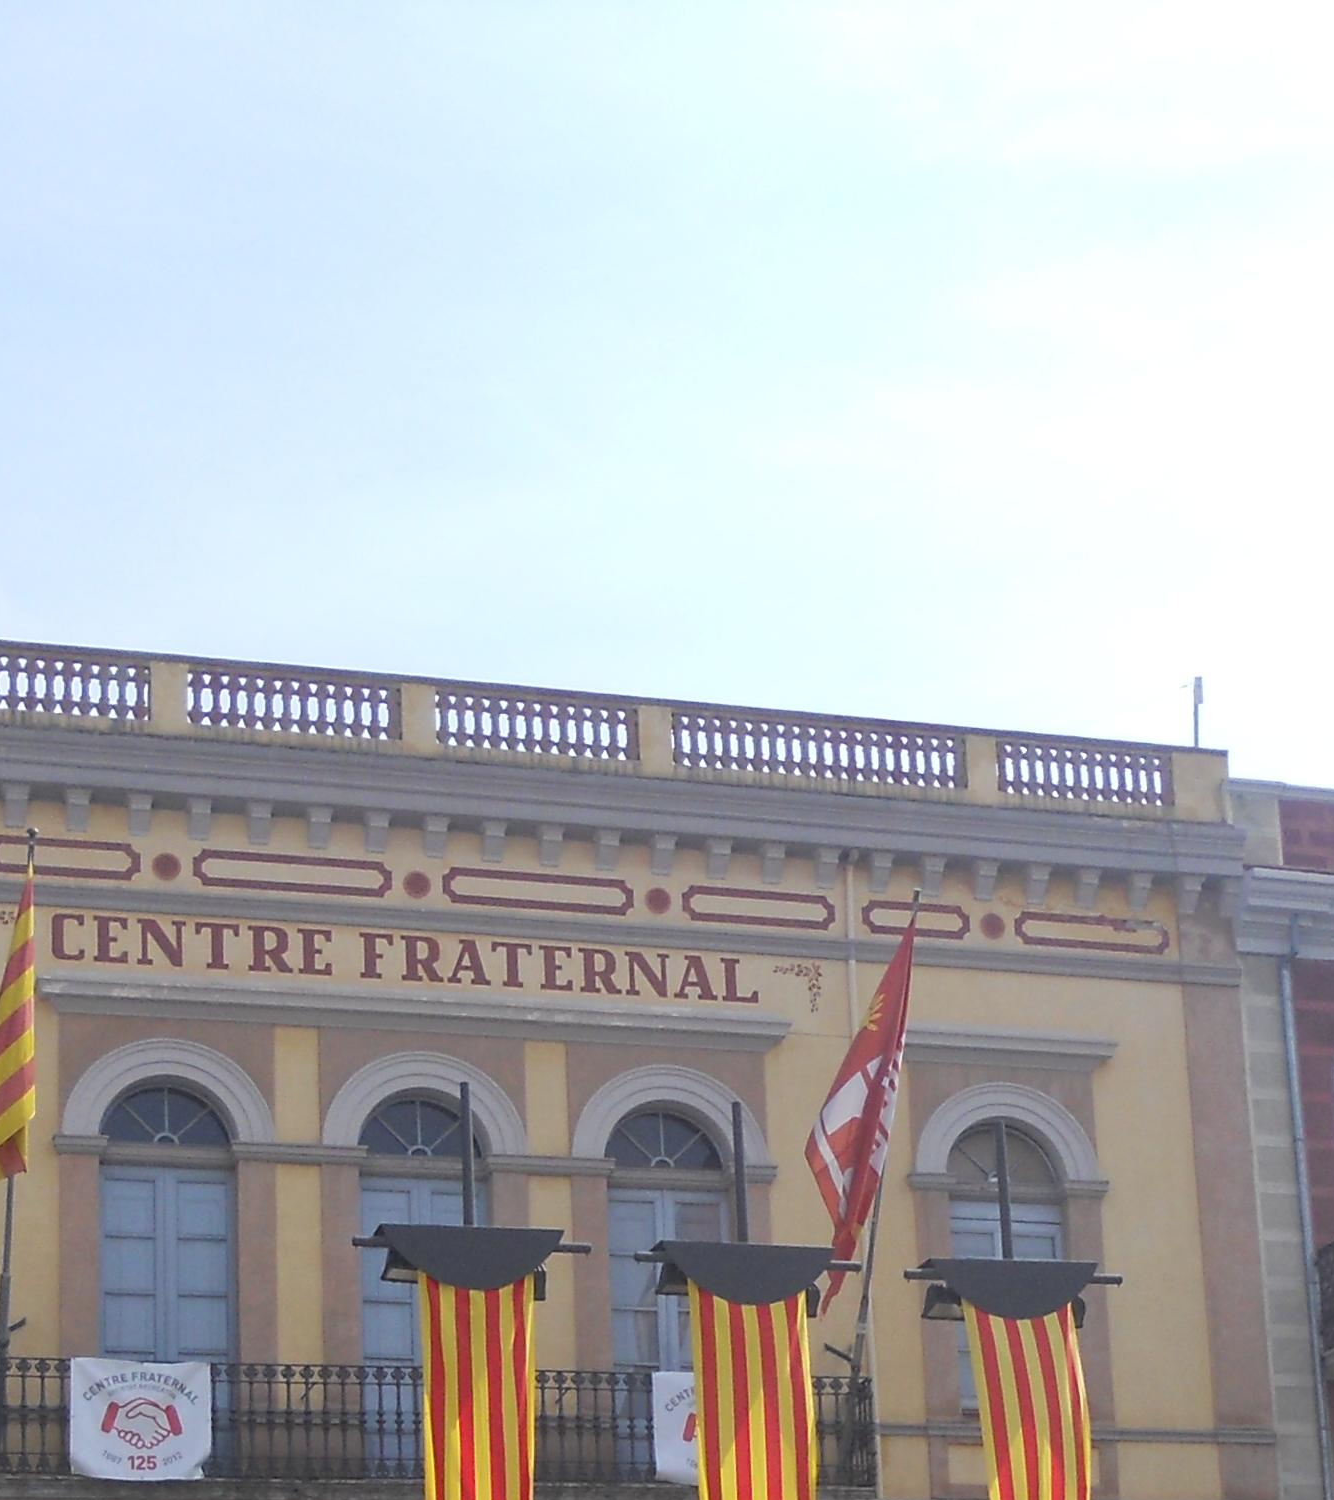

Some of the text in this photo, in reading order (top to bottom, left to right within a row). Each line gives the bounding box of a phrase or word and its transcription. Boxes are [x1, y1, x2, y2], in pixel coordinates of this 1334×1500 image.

[51, 913, 759, 1003] CENTRE FRATERNAL
[82, 1372, 128, 1402] CENTRE
[131, 1371, 199, 1405] FRATERNAL
[127, 1455, 157, 1470] 125
